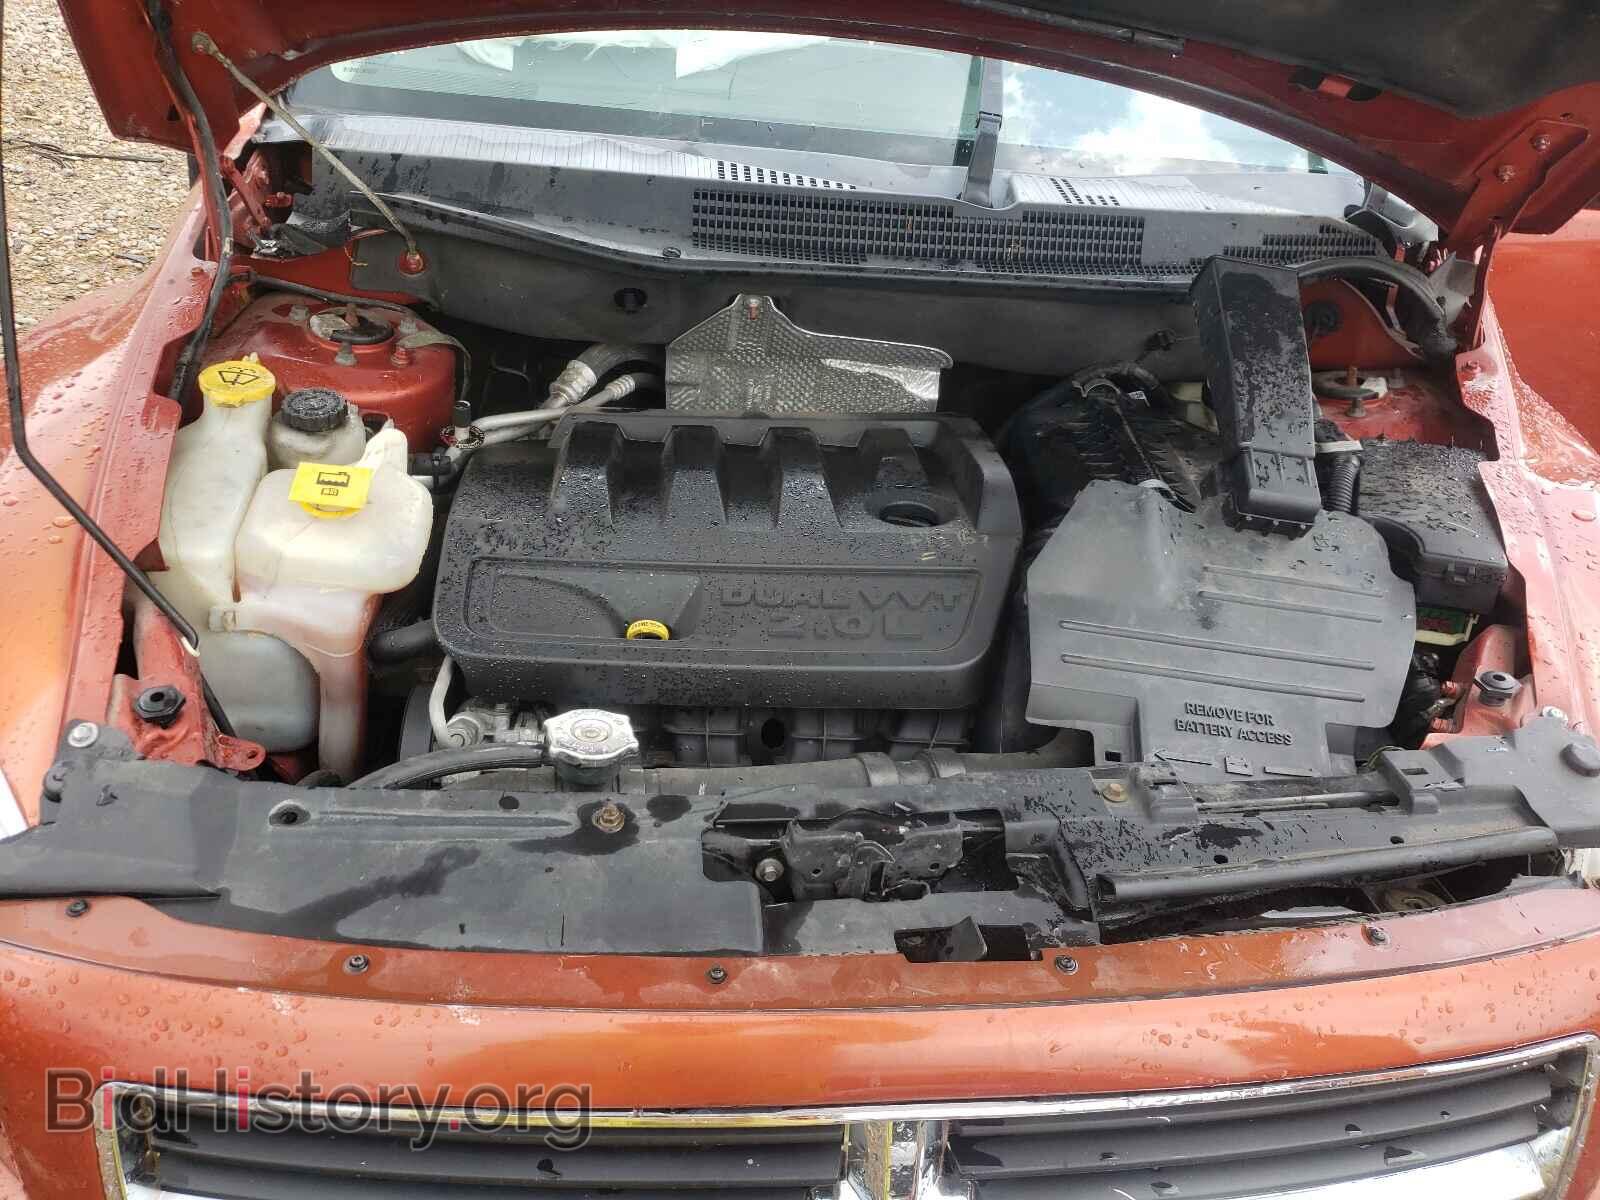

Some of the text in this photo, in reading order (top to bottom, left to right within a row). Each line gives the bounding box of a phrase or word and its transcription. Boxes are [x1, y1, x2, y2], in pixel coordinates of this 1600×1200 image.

[720, 586, 963, 611] DUAL VVT
[1184, 702, 1275, 726] REMOVE FOR
[1175, 718, 1293, 746] BATTERY ACCESS
